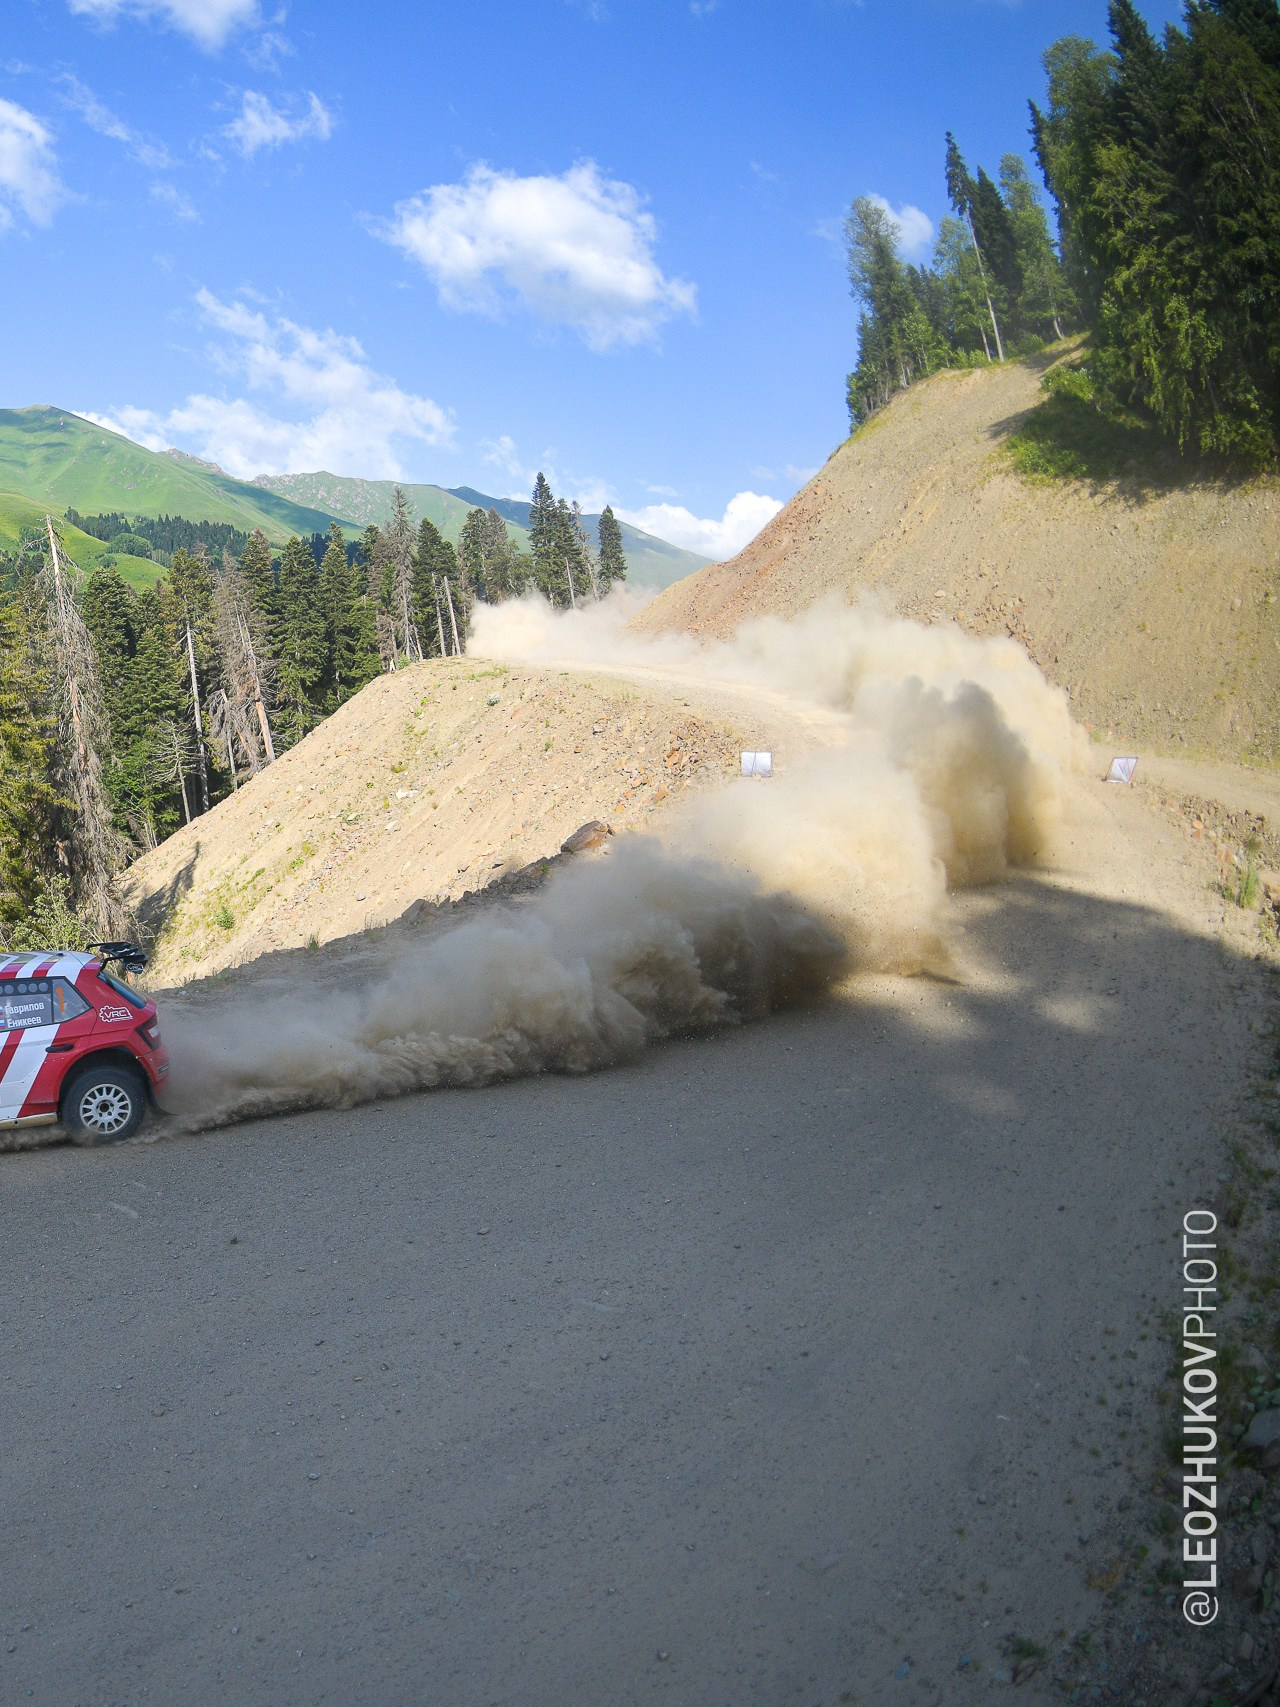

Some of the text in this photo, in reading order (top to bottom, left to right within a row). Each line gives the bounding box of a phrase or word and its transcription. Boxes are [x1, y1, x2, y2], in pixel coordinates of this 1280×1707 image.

[56, 987, 65, 1013] 1
[5, 1002, 45, 1015] Гаврилов
[104, 1009, 127, 1019] VRC
[6, 1016, 42, 1029] Еникеев
